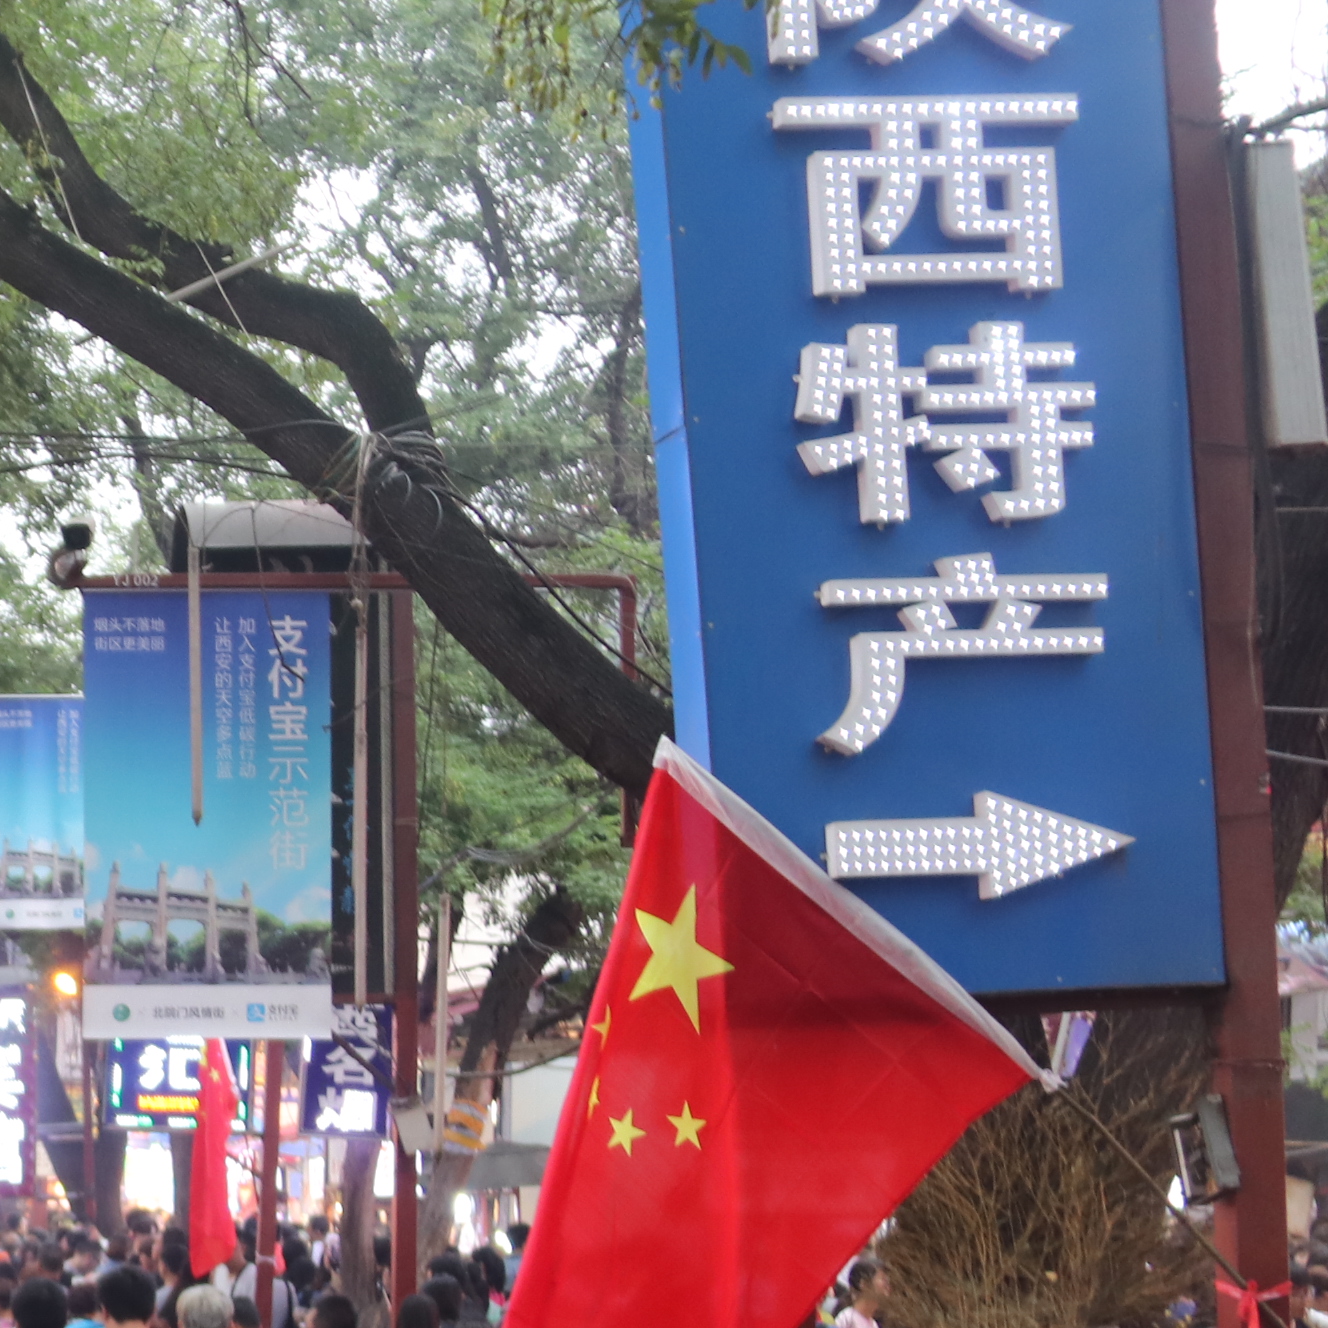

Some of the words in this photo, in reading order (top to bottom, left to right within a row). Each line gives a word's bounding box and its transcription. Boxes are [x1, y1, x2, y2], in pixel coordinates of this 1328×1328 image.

[766, 0, 1109, 757] 西特产
[133, 574, 159, 588] 002
[267, 614, 310, 871] 支付宝示范街
